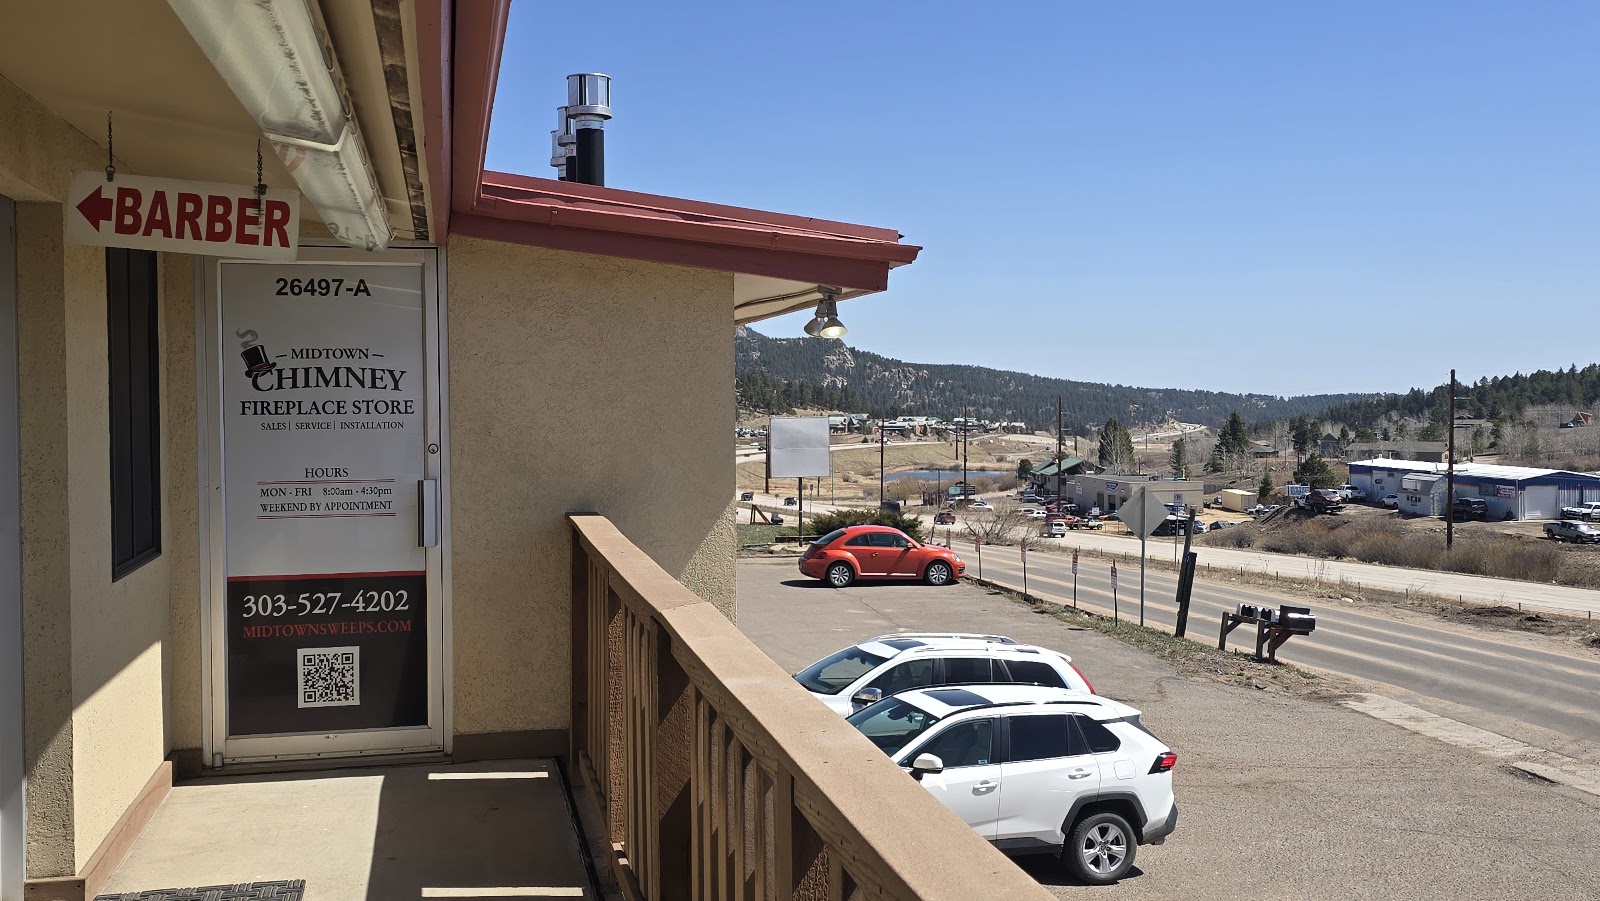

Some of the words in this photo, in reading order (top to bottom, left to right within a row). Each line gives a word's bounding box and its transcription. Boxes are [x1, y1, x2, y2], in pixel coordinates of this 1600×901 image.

[115, 186, 291, 248] BARBER
[275, 278, 371, 297] 26497-A
[291, 348, 369, 360] MIDTOWN
[251, 366, 407, 392] CHIMNEY
[240, 400, 347, 416] FIREPLACE
[352, 398, 415, 415] STORE
[261, 422, 287, 431] SALES
[295, 421, 332, 430] SERVICE
[340, 421, 404, 430] INSTALLATION
[304, 467, 349, 478] HOURS
[260, 487, 287, 497] MON
[294, 487, 312, 497] FRI
[322, 487, 353, 496] 8:00am
[361, 486, 392, 497] 4:30pm
[260, 502, 307, 513] WEEKEND
[310, 502, 322, 511] BY
[324, 501, 392, 511] APPOINTMENT
[242, 590, 409, 618] 303-527-4202
[243, 620, 412, 639] MIDTOWNSWEEPS.COM
